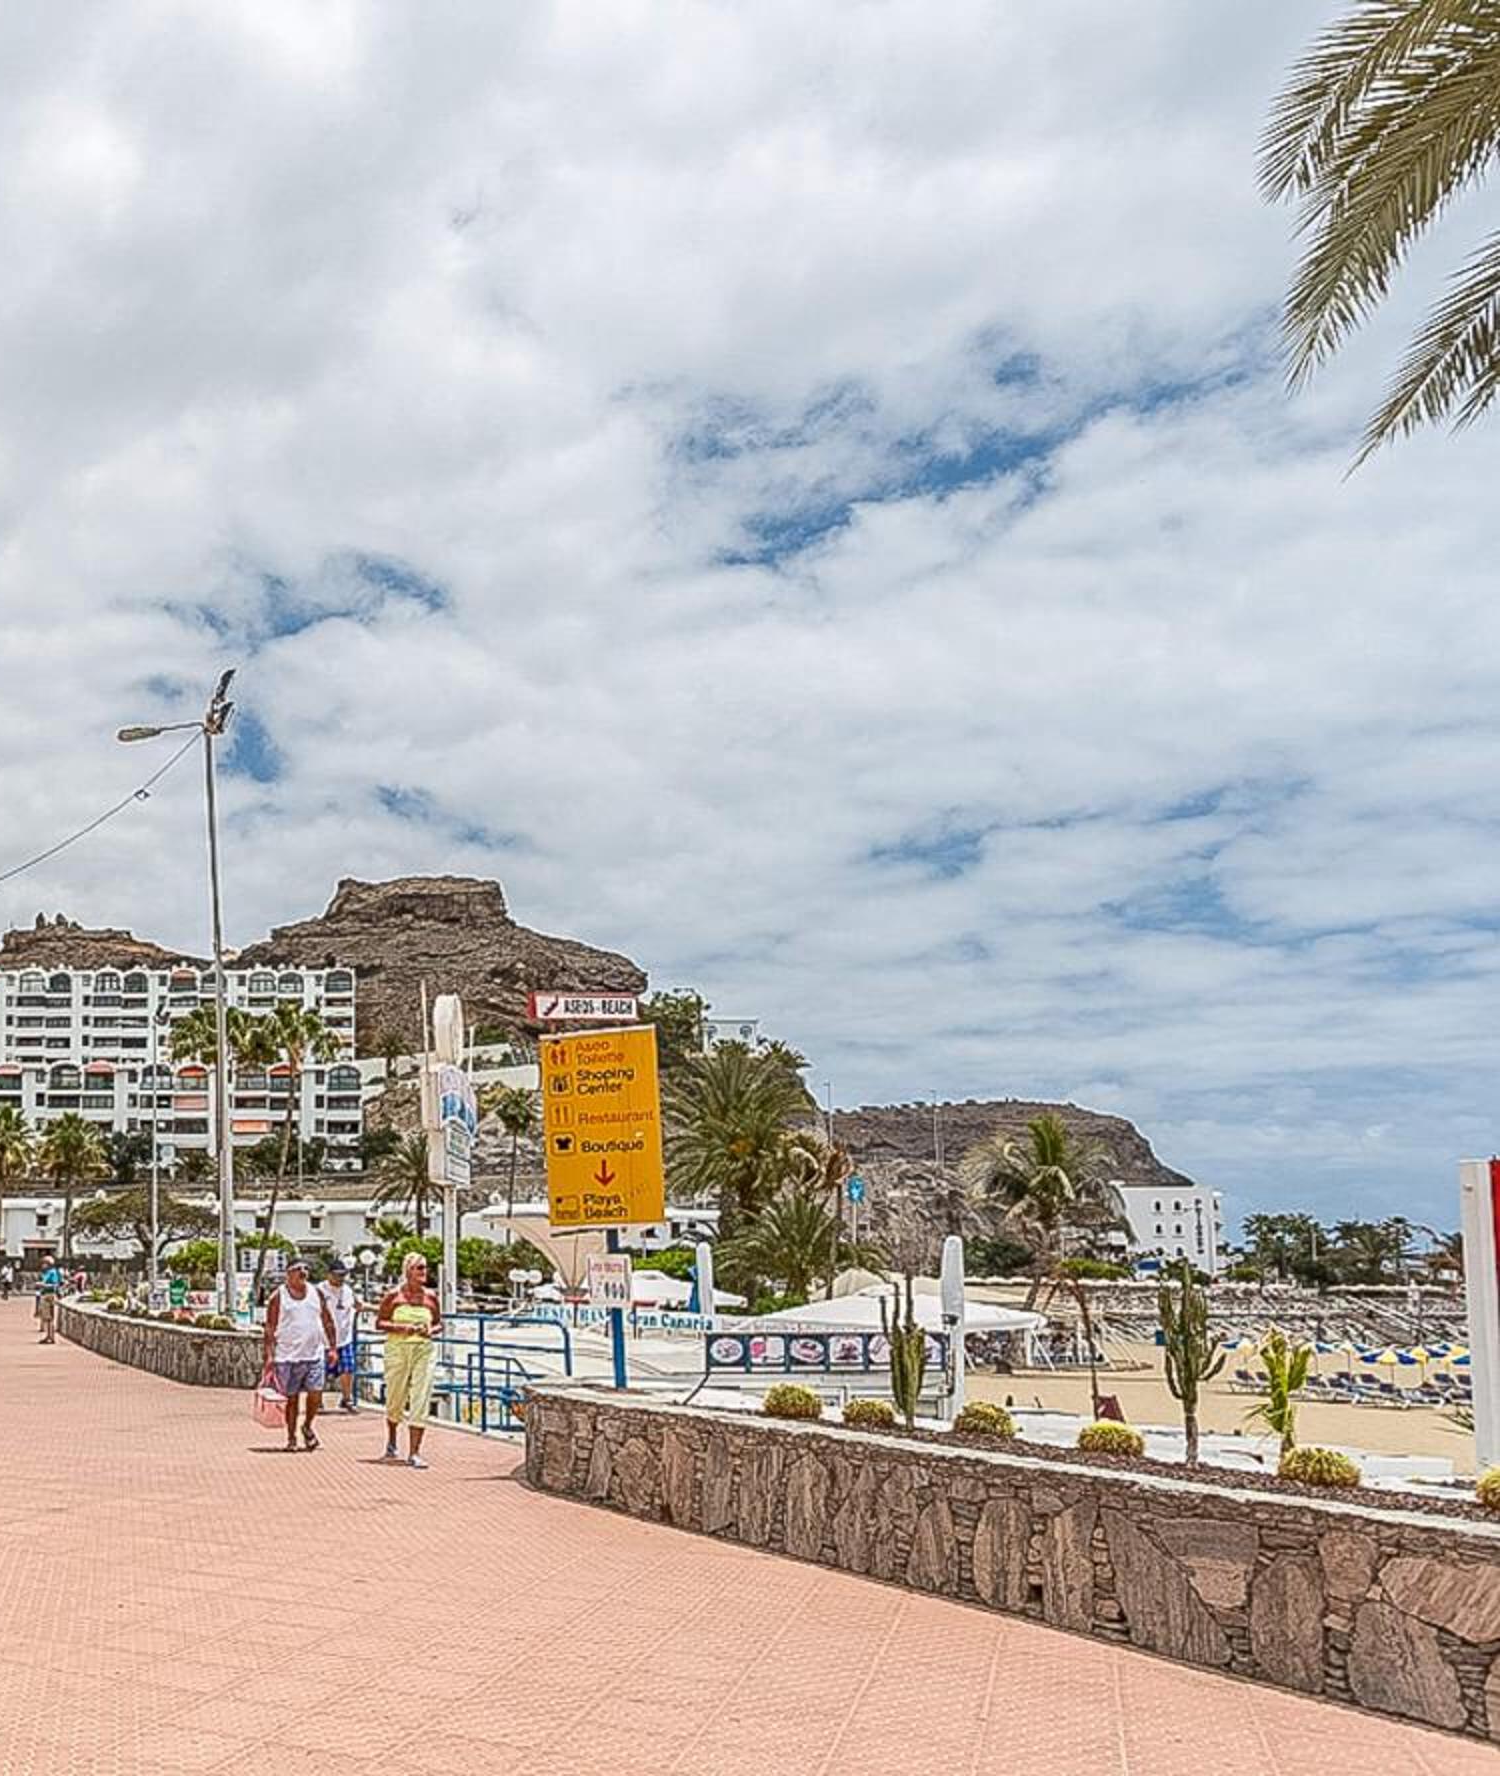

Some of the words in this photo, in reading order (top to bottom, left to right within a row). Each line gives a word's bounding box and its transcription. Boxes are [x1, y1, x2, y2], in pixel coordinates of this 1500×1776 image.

[577, 1082, 623, 1096] Center
[579, 1109, 654, 1124] Restaurant
[581, 1140, 645, 1152] Boutique
[582, 1193, 621, 1206] Playa
[583, 1205, 628, 1219] Beach
[626, 1311, 658, 1327] Gran
[660, 1312, 713, 1332] Canaria
